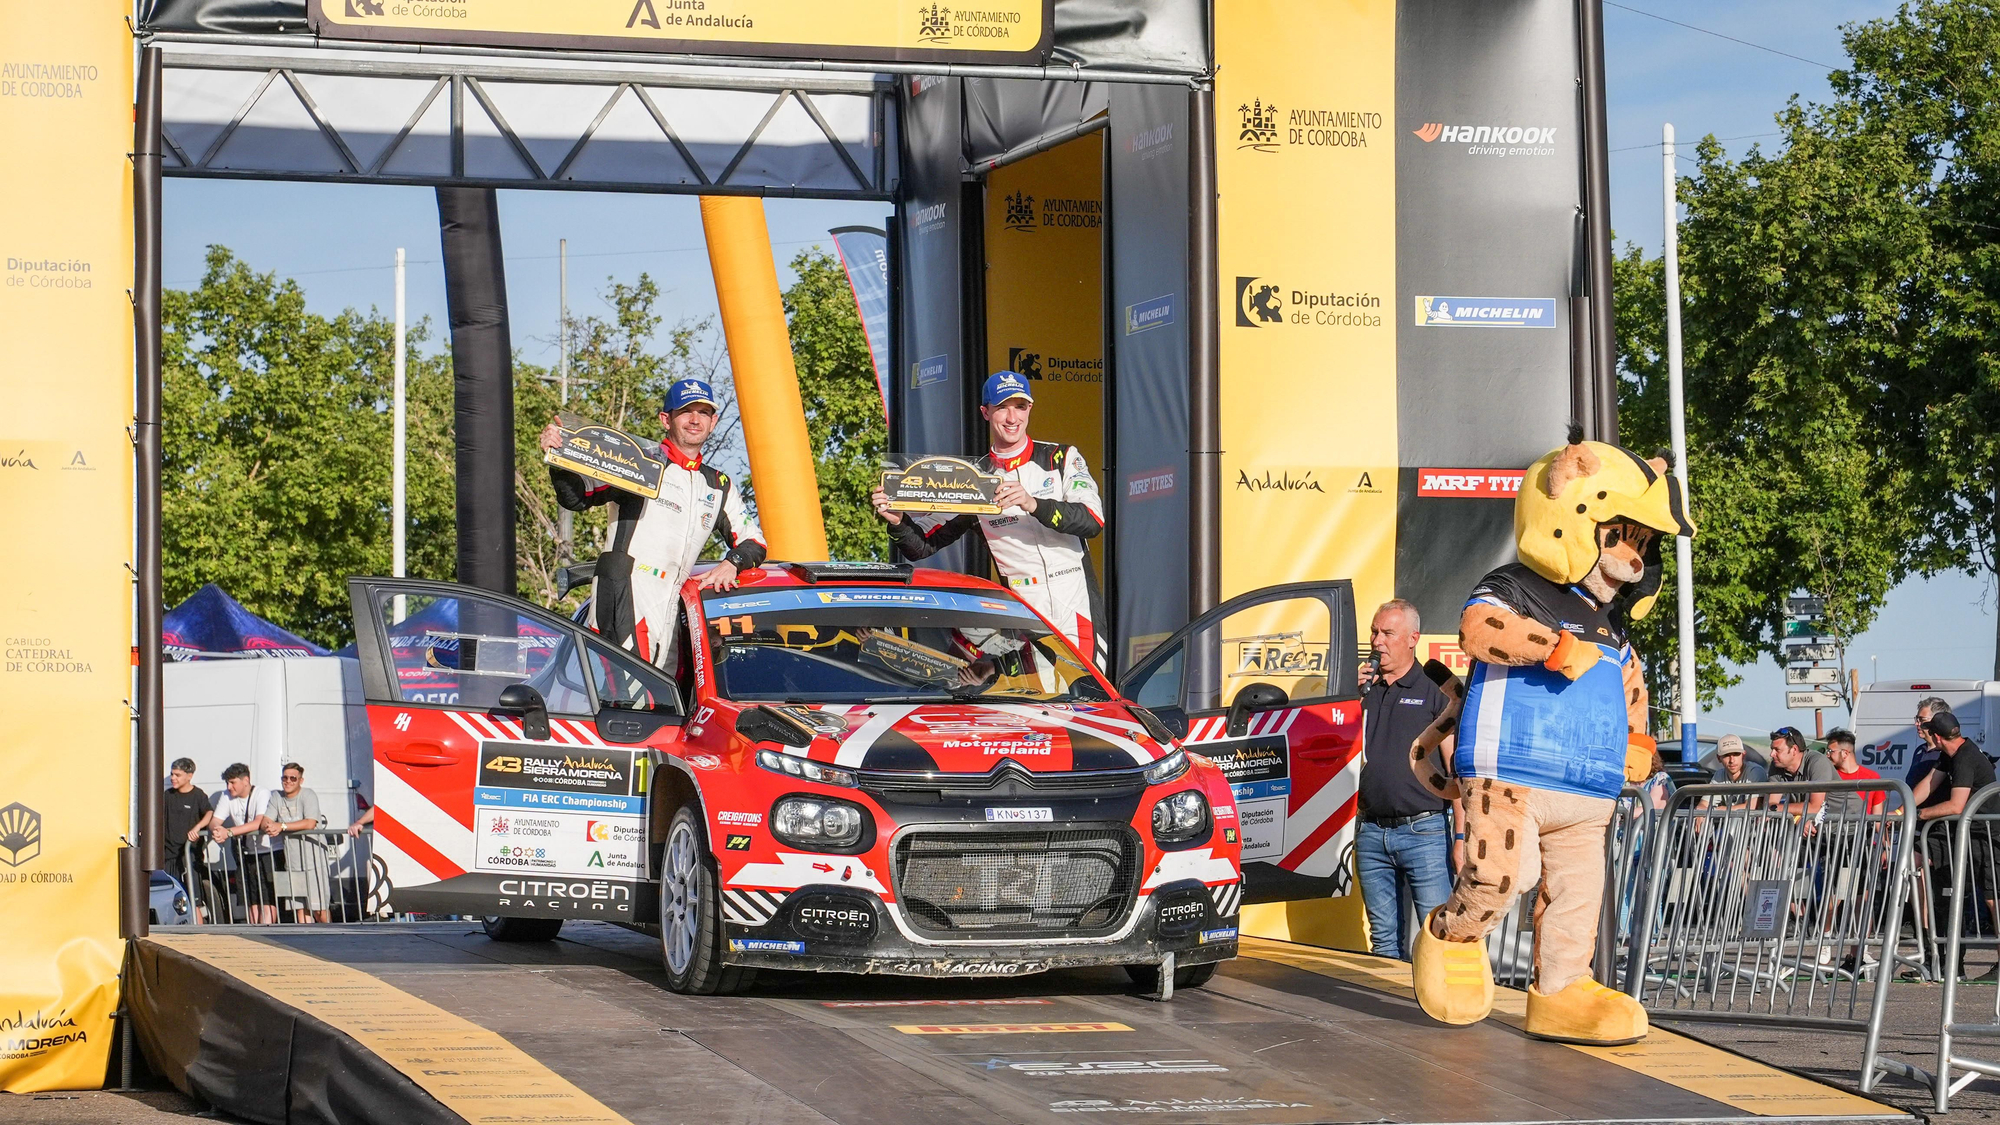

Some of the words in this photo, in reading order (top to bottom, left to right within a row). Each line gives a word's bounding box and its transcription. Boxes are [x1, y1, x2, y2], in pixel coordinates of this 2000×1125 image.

[392, 4, 409, 16] de
[413, 4, 467, 18] Córdoba
[666, 0, 705, 11] Junta
[666, 13, 684, 26] de
[686, 14, 754, 29] Andalucía
[953, 10, 1021, 24] AYUNTAMIENTO
[953, 25, 965, 37] DE
[966, 24, 1010, 38] CÓRDOBA
[2, 62, 98, 81] AYUNTAMIENTO
[2, 81, 17, 97] DE
[1289, 108, 1382, 130] AYUNTAMIENTO
[1289, 130, 1303, 145] DE
[1307, 130, 1367, 148] CORDOBA
[1468, 144, 1506, 158] driving
[1509, 144, 1555, 156] emotion
[1043, 199, 1103, 214] AYUNTAMIEN
[1043, 214, 1055, 226] DE
[7, 256, 91, 273] Diputación
[6, 275, 23, 288] de
[29, 274, 92, 289] Córdoba
[1291, 290, 1381, 309] Diputación
[1138, 305, 1170, 323] MICHELIN
[1291, 310, 1310, 325] de
[1315, 311, 1381, 327] Córdoba
[1455, 306, 1543, 319] MICHELIN
[1048, 357, 1103, 370] Diputació
[1048, 371, 1062, 381] de
[1065, 371, 1103, 383] Córdob
[592, 443, 640, 471] Andalucía
[563, 447, 600, 467] SIERRA
[601, 460, 646, 482] MORENA
[901, 475, 923, 486] 43
[926, 476, 980, 491] Andalucía
[1129, 477, 1151, 496] MRF
[1151, 473, 1174, 492] TYRES
[1236, 469, 1326, 493] Andalucía
[1422, 475, 1485, 491] MRF
[1488, 476, 1525, 491] TYR
[896, 490, 936, 499] SIERRA
[938, 491, 987, 501] MORENA
[989, 515, 1020, 527] CREIGHTONS
[709, 615, 754, 636] 11
[5, 638, 51, 647] CABILDO
[5, 649, 73, 660] CATEDRAL
[5, 662, 23, 672] DE
[26, 660, 93, 673] CÓRDOBA
[1790, 696, 1814, 704] GRANADA
[943, 739, 1052, 750] Motorsport
[983, 746, 1052, 755] Ireland
[1235, 745, 1277, 761] Andalucía
[485, 755, 522, 774] 43
[524, 757, 562, 768] RALLY
[563, 755, 616, 772] Andalucía
[1241, 756, 1283, 769] MORENA
[523, 766, 568, 776] SIERRA
[569, 768, 623, 781] MORENA
[1229, 769, 1254, 778] CÓRDOBA
[554, 777, 587, 786] CÓRDOBA
[522, 793, 539, 803] FIA
[541, 794, 560, 804] ERC
[562, 795, 627, 810] Championship
[717, 811, 763, 823] CREIGHTONS
[1241, 809, 1274, 819] Diputación
[1250, 816, 1274, 825] Córdoba
[514, 819, 560, 828] AYUNTAMIENTO
[613, 825, 645, 835] Diputaci
[523, 827, 552, 837] CÓRDOBA
[624, 834, 646, 842] Córdo
[1244, 840, 1271, 850] Andalucía
[487, 857, 530, 866] CÓRDOBA
[617, 861, 645, 869] Andaluc
[30, 870, 73, 883] CÓRDOBA
[499, 899, 629, 912] RACING
[801, 918, 870, 928] RACING
[1161, 912, 1204, 923] RACING
[1208, 930, 1236, 939] MICHELIN
[747, 942, 801, 951] MICHELIN
[8, 1030, 88, 1051] MORENA
